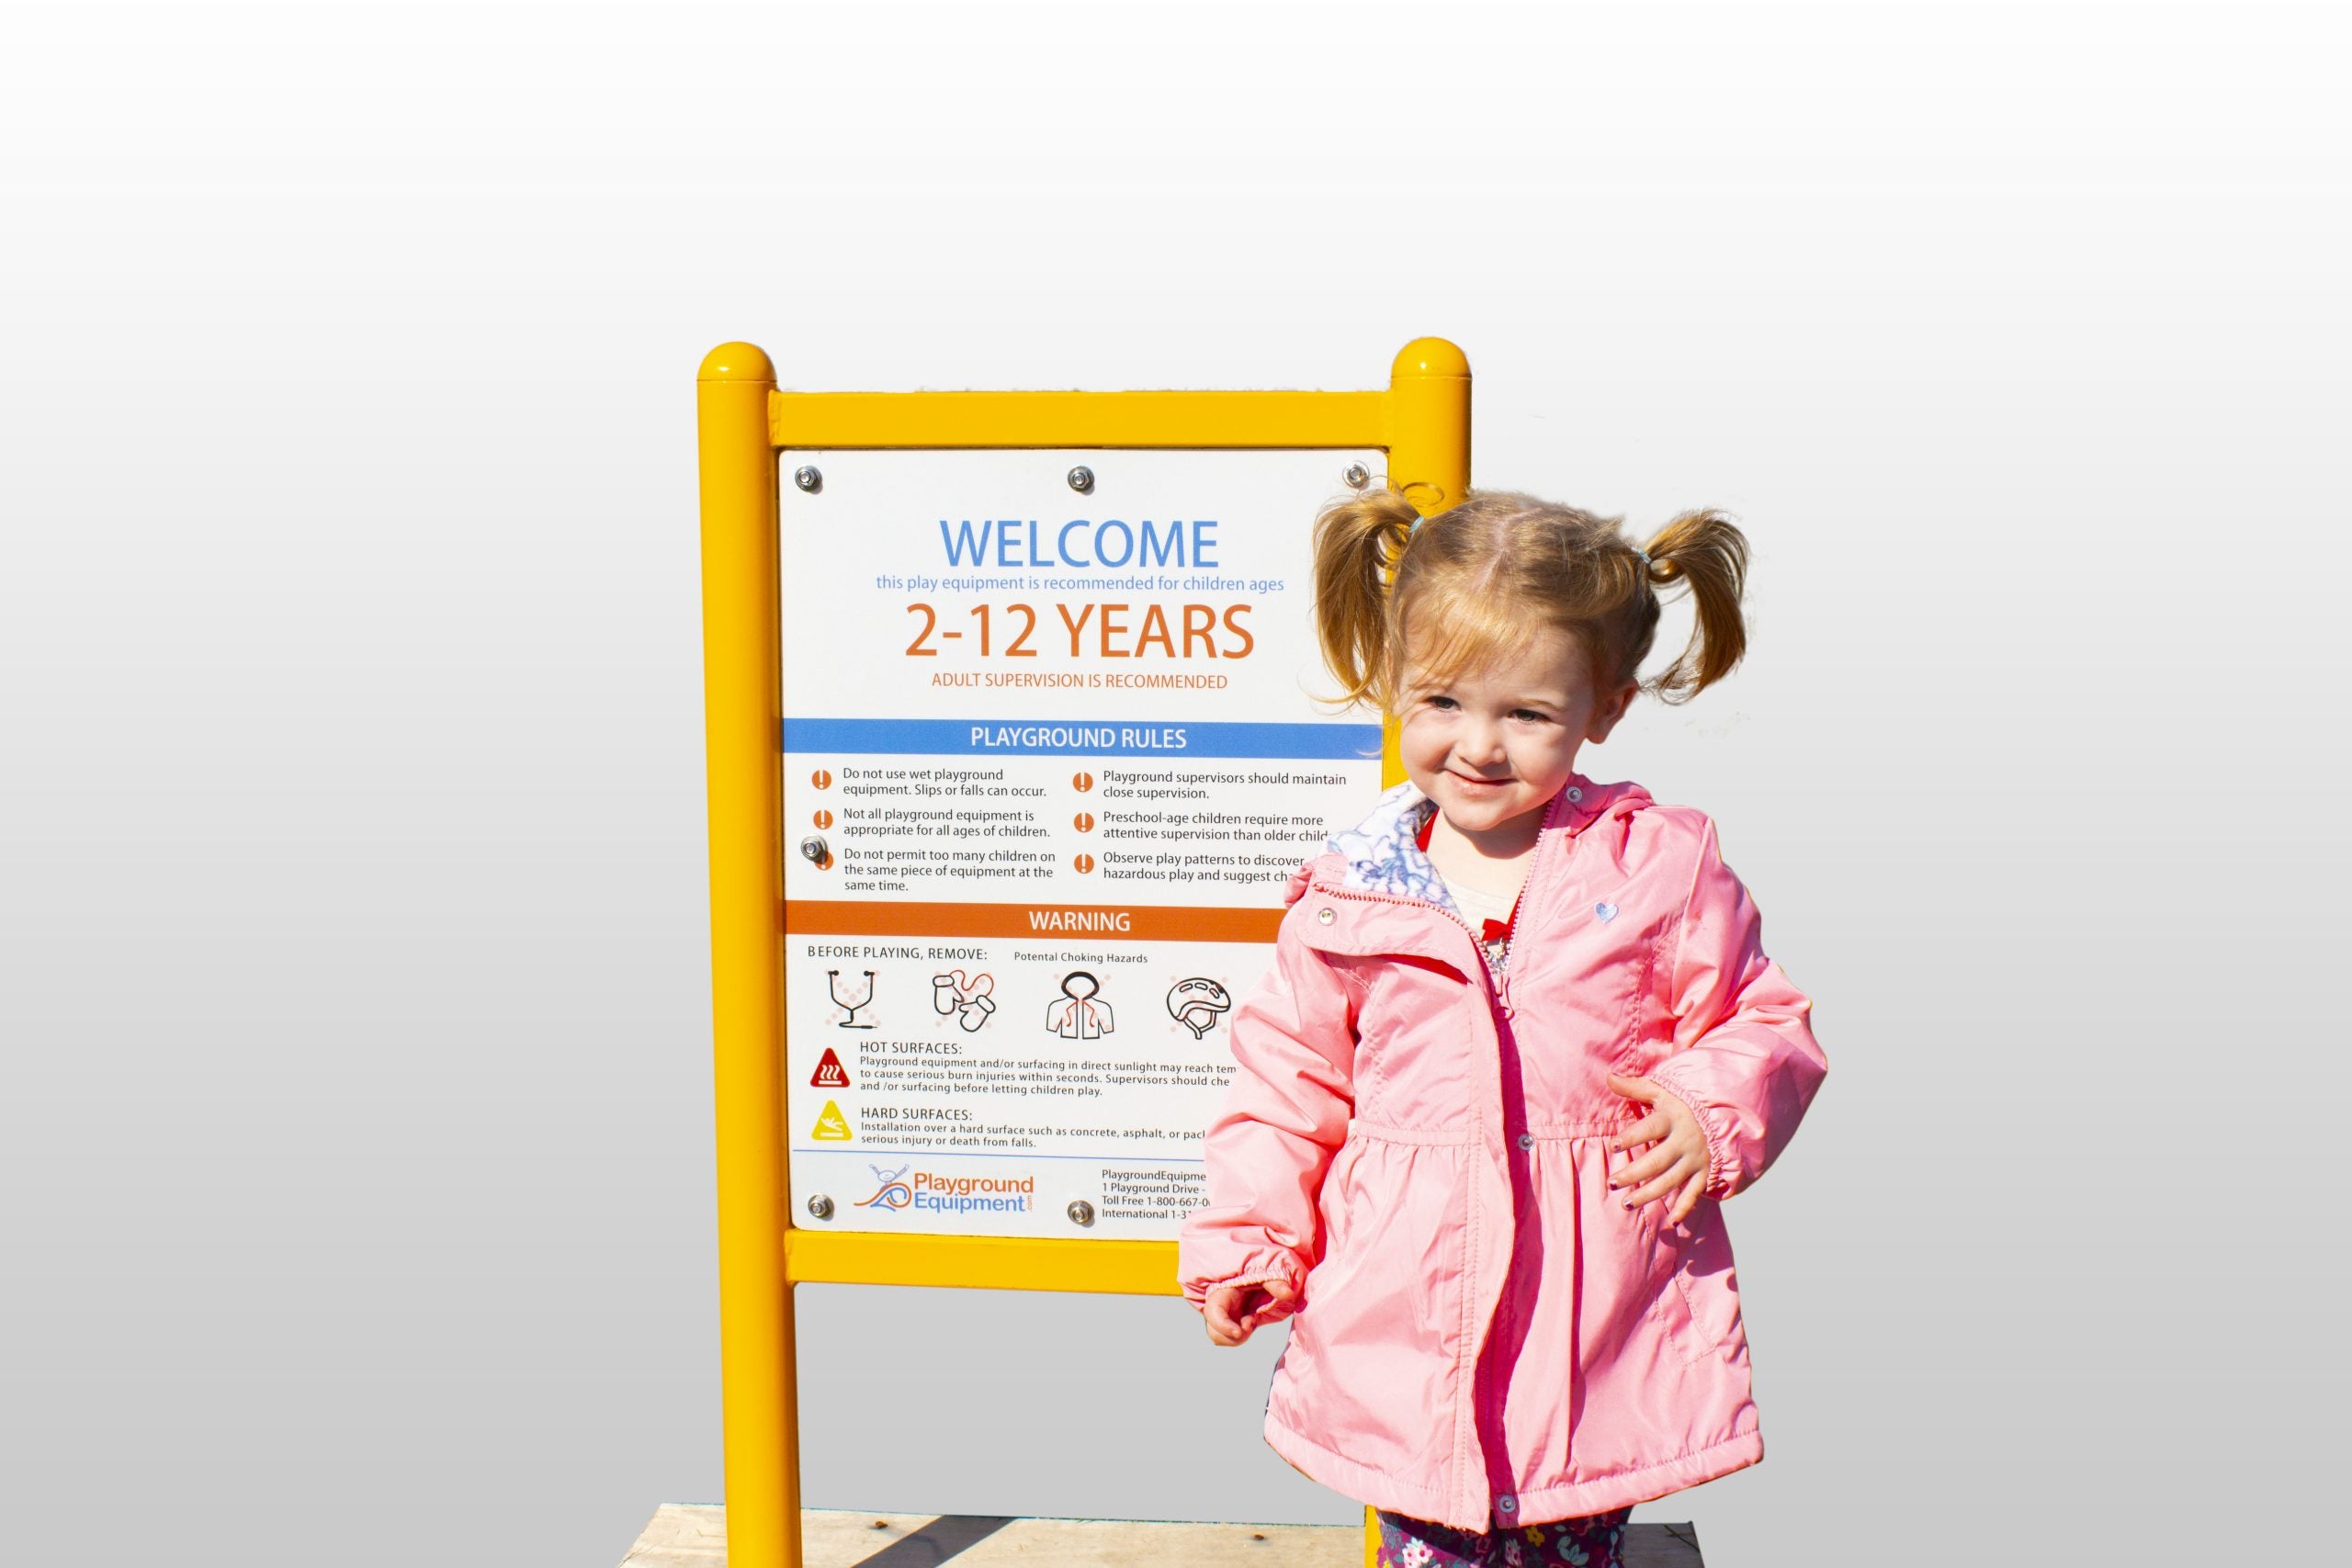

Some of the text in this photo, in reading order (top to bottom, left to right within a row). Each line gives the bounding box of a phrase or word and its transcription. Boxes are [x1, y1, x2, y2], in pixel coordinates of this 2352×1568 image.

[939, 520, 1218, 568] WELCOME
[876, 574, 1284, 594] this play equipment is recommended for children ages
[906, 604, 1254, 660] 2-12 YEARS
[932, 672, 1227, 689] ADULT SUPERVISION IS RECOMMENDED
[971, 727, 1187, 749] PLAYGROUND RULES
[843, 767, 1003, 783] Do not use wet playground
[1103, 770, 1346, 785] Playground supervisors should maintain
[843, 784, 1046, 798] equipment. Slips or falls can occur.
[1103, 786, 1209, 800] close supervision.
[844, 808, 1035, 823] Not all playground equipment is
[1103, 811, 1323, 828] Preschool-age children require more
[843, 824, 1050, 839] appropriate for all ages of children.
[1103, 828, 1328, 841] attentive supervision than older child
[844, 848, 1056, 863] Do not permit too many children on
[1103, 852, 1305, 867] Observe play patterns to discover
[844, 863, 1053, 879] the same piece of equipment at the
[1103, 867, 1293, 884] hazardous play and suggest ch
[845, 880, 909, 891] same time.
[1029, 911, 1131, 931] WARNING
[808, 945, 987, 960] BEFORE PLAYING, REMOVE:
[1014, 952, 1148, 964] Potental Choking Hazards
[860, 1042, 962, 1055] HOT SURFACES:
[860, 1055, 918, 1068] Playground
[922, 1058, 977, 1068] equipment
[980, 1059, 1014, 1068] and/or
[1018, 1059, 1065, 1072] surfacing
[1069, 1061, 1078, 1069] in
[1081, 1061, 1111, 1070] direct
[1114, 1062, 1157, 1074] sunlight
[1160, 1065, 1182, 1075] may
[1185, 1064, 1213, 1073] reach
[907, 1070, 944, 1079] serious
[948, 1070, 973, 1079] burn
[977, 1071, 1015, 1082] injuries
[1019, 1072, 1053, 1081] within
[1057, 1073, 1102, 1083] seconds.
[1105, 1074, 1168, 1086] Supervisors
[1171, 1076, 1207, 1086] should
[1211, 1077, 1229, 1087] che
[860, 1081, 1102, 1098] and /or surfacing before letting children play.
[861, 1107, 972, 1121] HARD SURFACES:
[861, 1122, 921, 1132] Installation
[959, 1123, 983, 1134] hard
[987, 1124, 1025, 1134] surface
[1028, 1126, 1052, 1135] such
[1070, 1129, 1119, 1138] concrete,
[1123, 1128, 1165, 1140] asphalt,
[862, 1134, 899, 1144] serious
[902, 1135, 933, 1146] injury
[949, 1136, 979, 1145] death
[983, 1136, 1008, 1146] from
[1012, 1137, 1036, 1147] falls.
[1102, 1169, 1206, 1183] PlaygroundEquipme
[914, 1173, 1034, 1195] Playground
[1111, 1182, 1170, 1195] Playground
[1172, 1184, 1199, 1194] Drive
[914, 1192, 1025, 1213] Equipment
[1102, 1196, 1210, 1207] Toll Free 1-800-667-0
[1102, 1208, 1168, 1219] International
